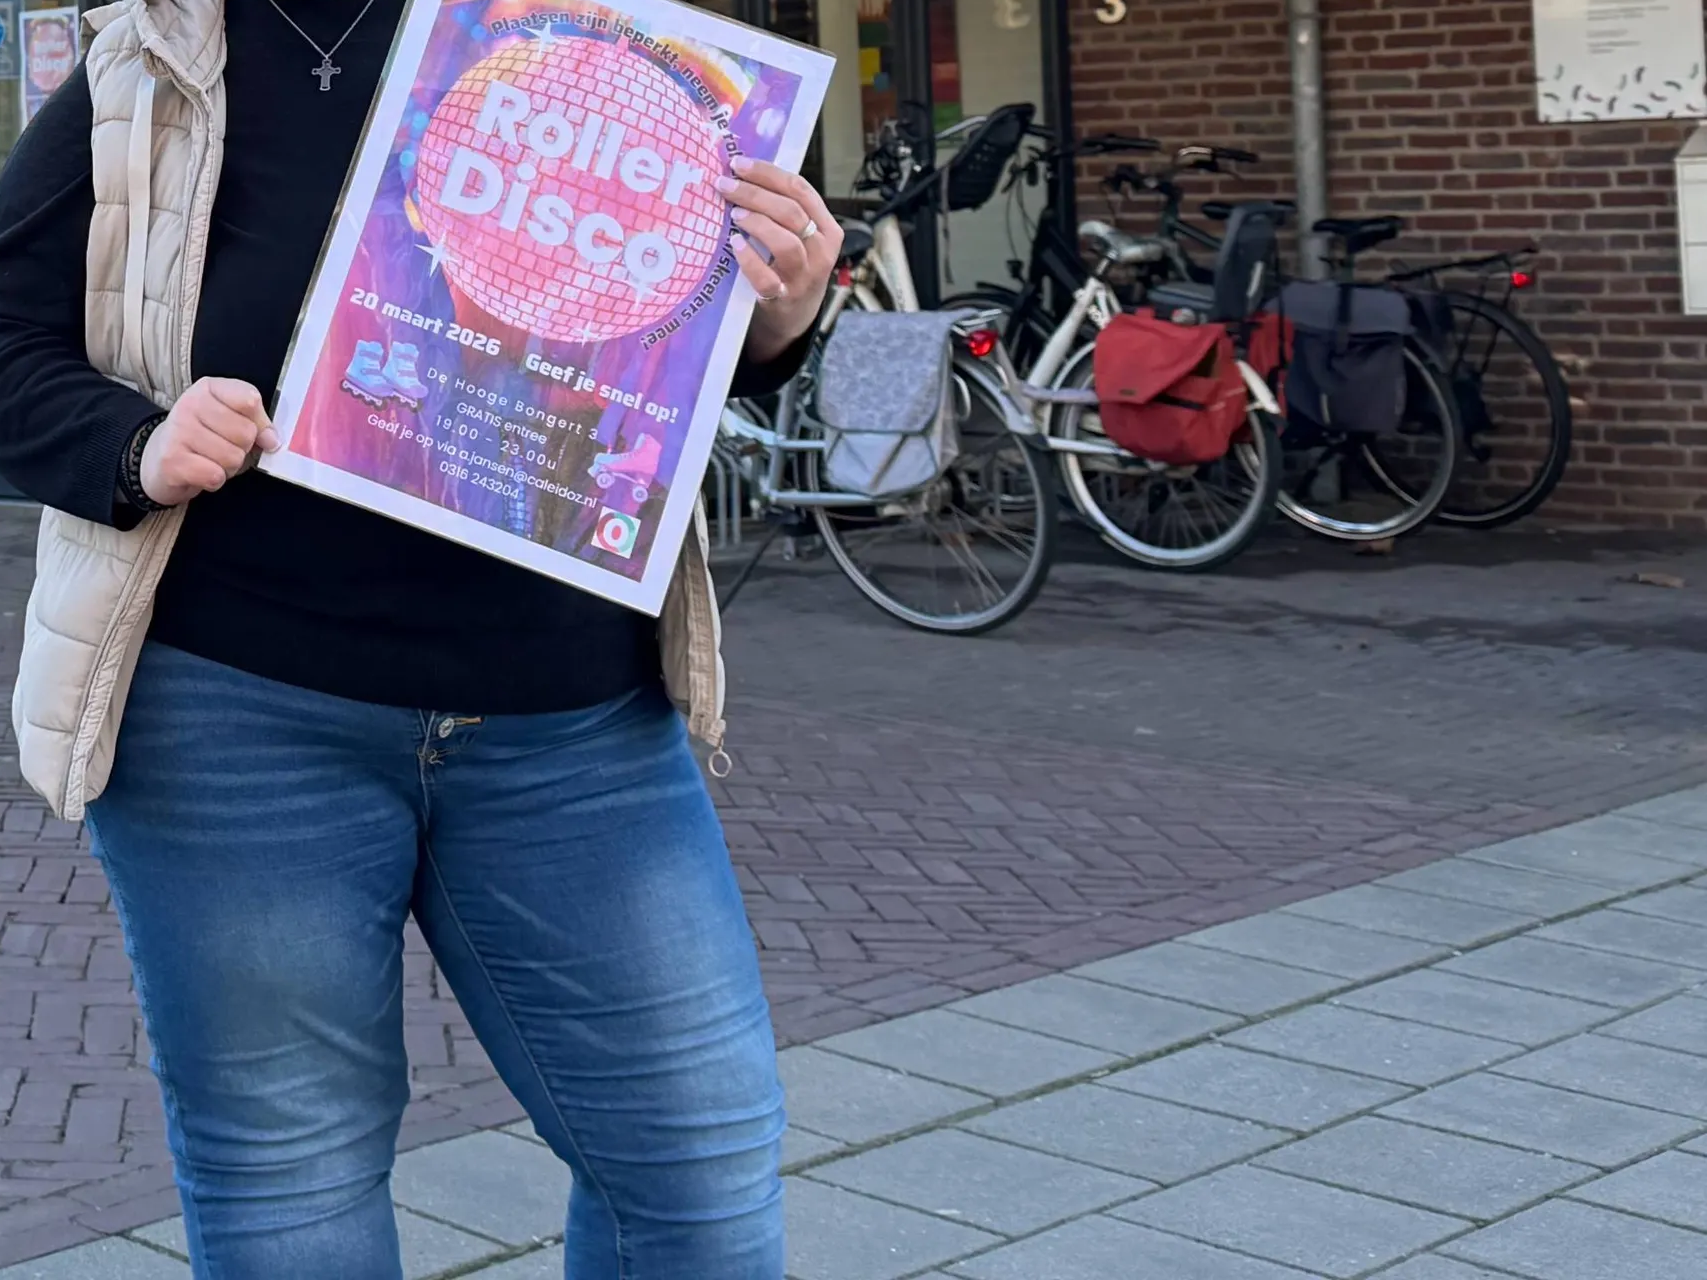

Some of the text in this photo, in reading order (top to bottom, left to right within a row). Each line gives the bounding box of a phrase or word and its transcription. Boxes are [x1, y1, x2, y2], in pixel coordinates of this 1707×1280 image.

[491, 11, 570, 35] Plaatsen
[576, 11, 608, 30] zijn
[613, 18, 680, 70] beperkt,
[681, 66, 719, 111] neem
[475, 79, 704, 206] Roller
[709, 111, 729, 131] je
[439, 147, 678, 285] Disco
[349, 287, 502, 356] 20 maart 2026
[641, 317, 681, 351] mee!
[426, 367, 598, 440] De Hooge Bongert 3
[525, 352, 680, 424] Geef je snel op!
[436, 414, 479, 440] 19.00
[499, 440, 558, 471] 23.00u
[456, 402, 548, 445] GRATIS entree
[367, 413, 598, 509] Geef je op via a.jansen@caleidoz.nl
[439, 460, 520, 500] 0316 243204
